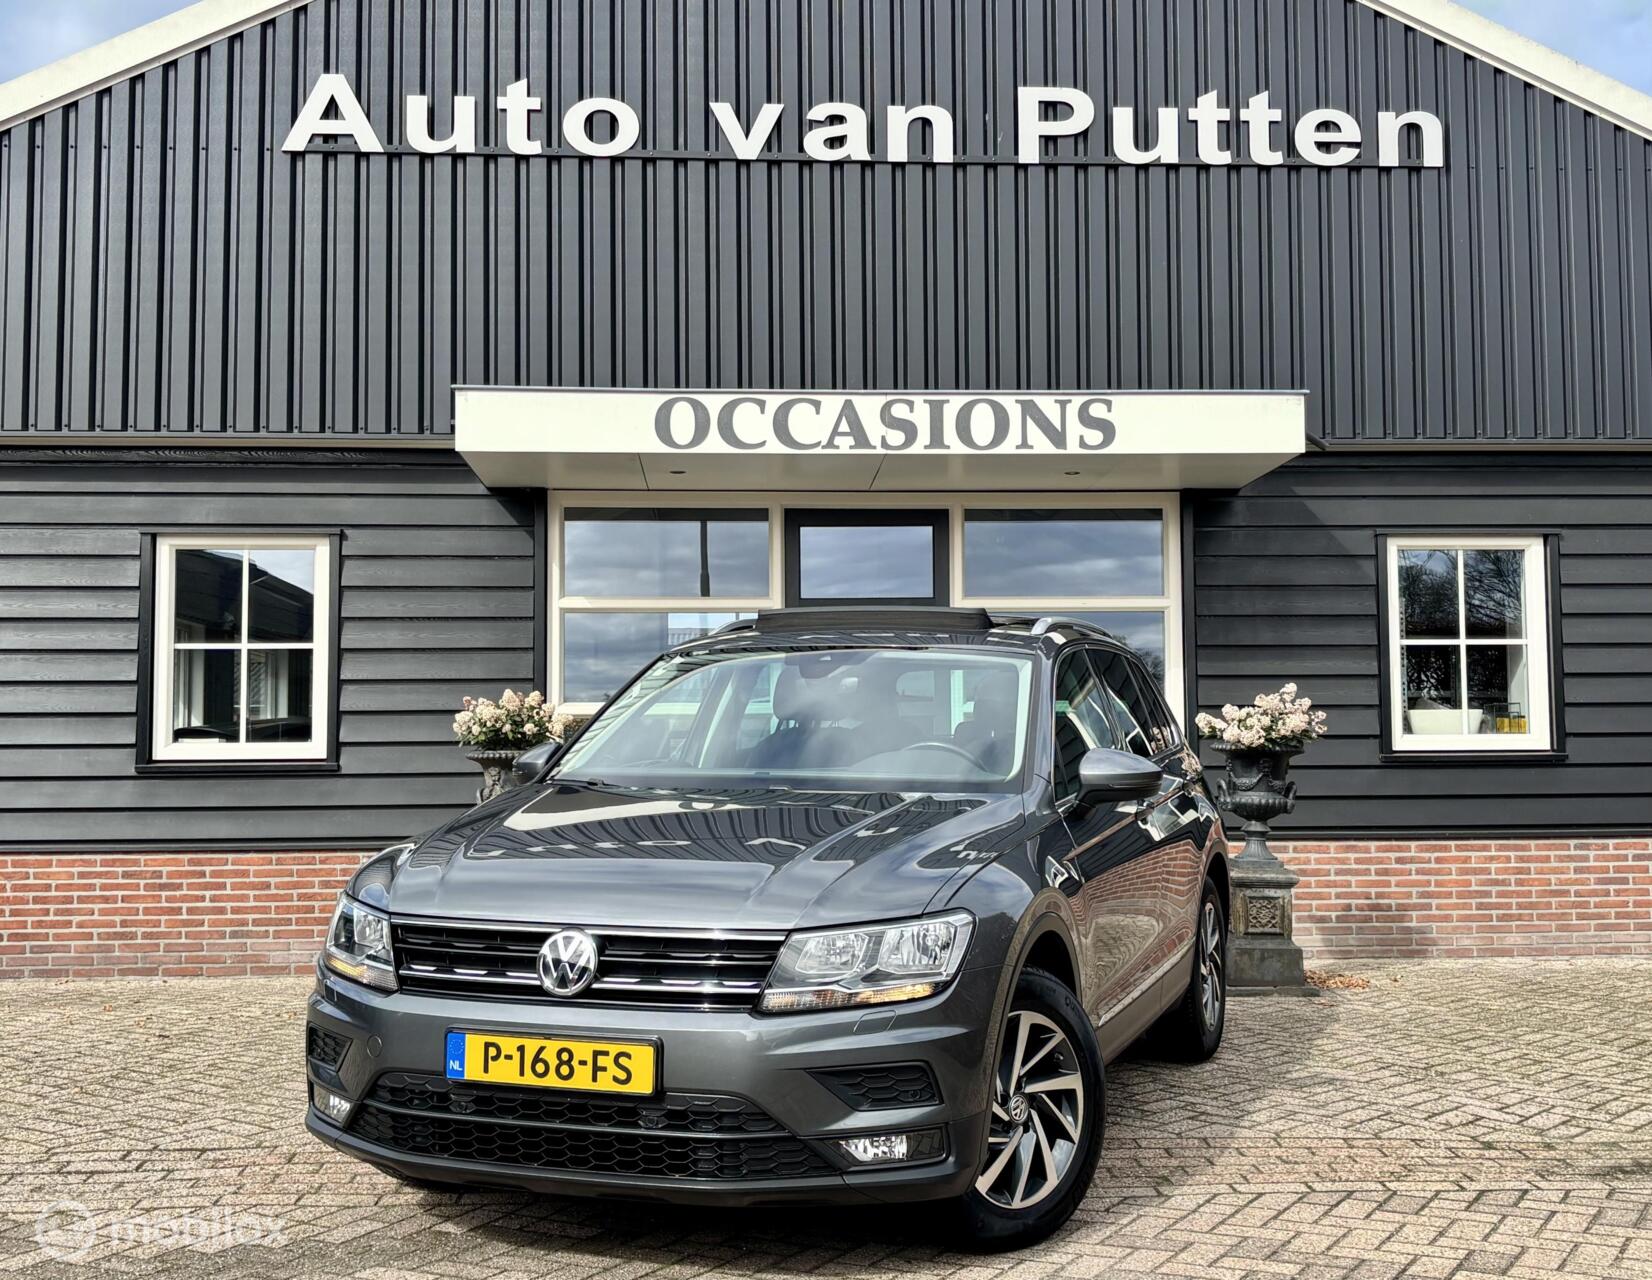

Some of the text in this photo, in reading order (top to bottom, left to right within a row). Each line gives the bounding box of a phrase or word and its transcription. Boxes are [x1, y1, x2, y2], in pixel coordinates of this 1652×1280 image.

[281, 74, 1443, 166] Auto van Putten
[655, 397, 1115, 450] OCCASIONS
[540, 930, 596, 994] VW
[450, 1060, 463, 1071] NL
[483, 1041, 633, 1086] P-168-FS
